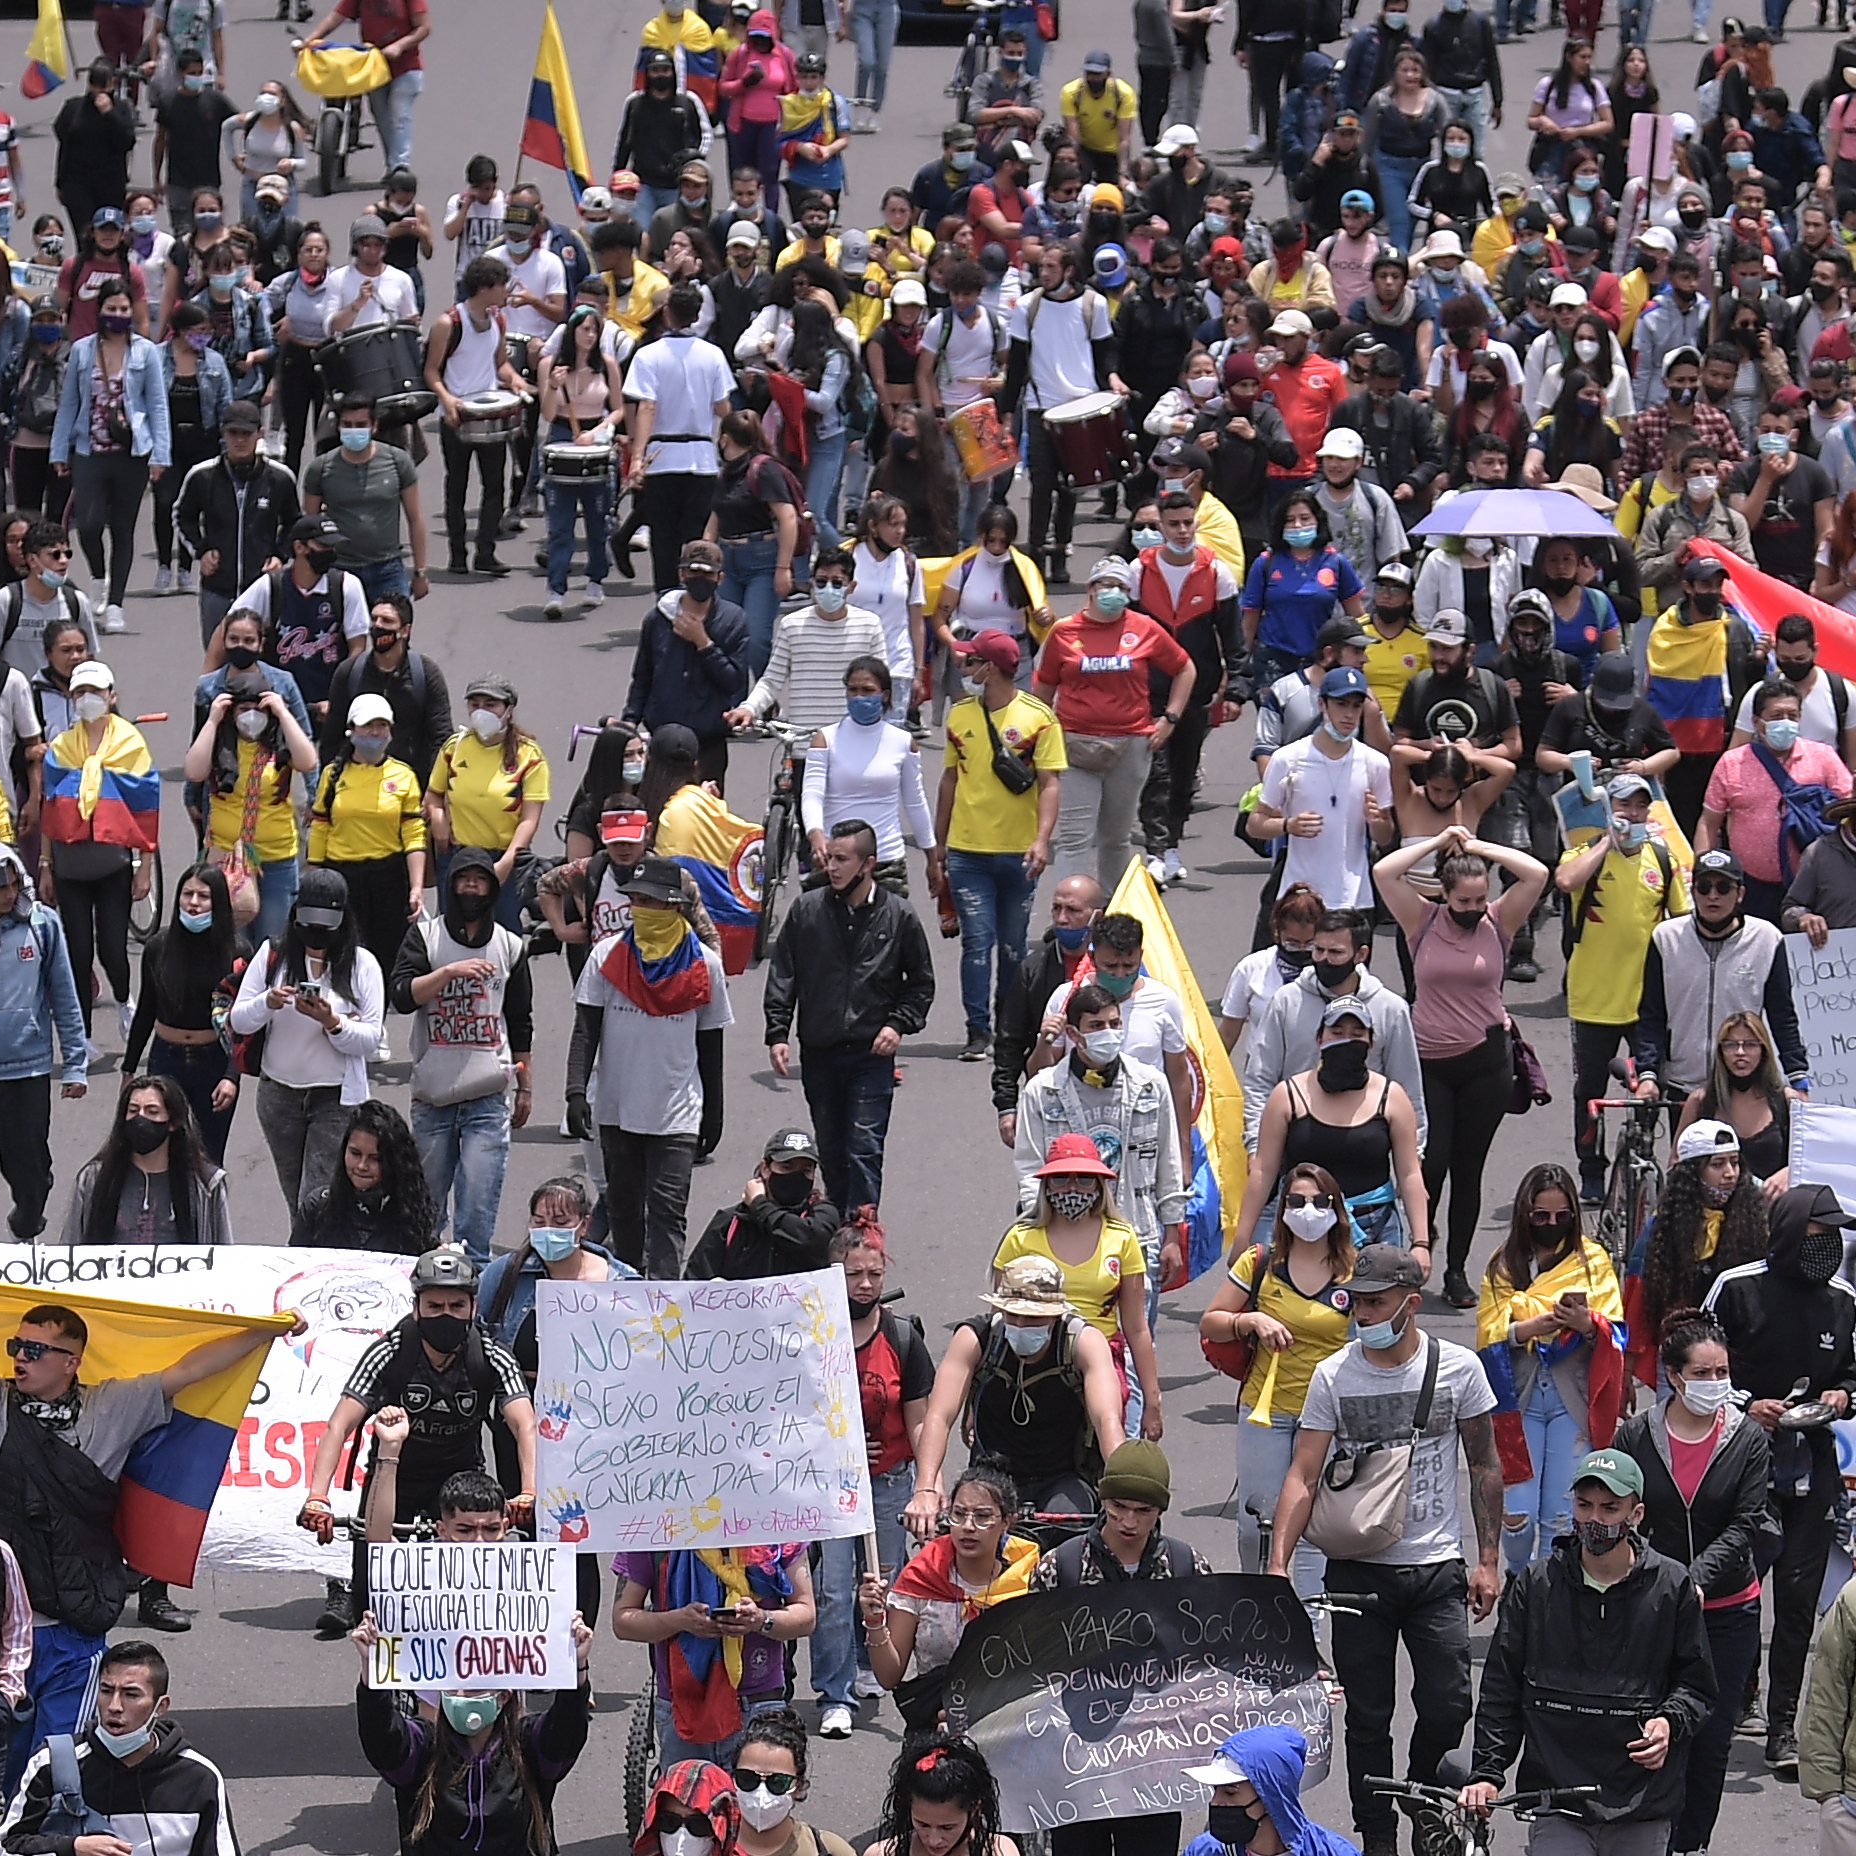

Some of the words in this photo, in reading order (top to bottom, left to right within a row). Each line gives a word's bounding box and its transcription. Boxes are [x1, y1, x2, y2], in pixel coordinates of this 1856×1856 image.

[597, 904, 633, 931] FUC
[441, 976, 484, 998] UCK
[441, 999, 474, 1018] THE
[558, 1288, 600, 1316] NO
[608, 1298, 638, 1312] A
[688, 1285, 798, 1313] REFORMA
[571, 1319, 632, 1374] NO
[659, 1318, 804, 1375] NECESITO
[408, 1418, 428, 1435] VA
[568, 1379, 658, 1431] SEXO
[567, 1418, 727, 1480] GOBIERNO
[1588, 1457, 1618, 1471] FILA
[585, 1466, 698, 1511] ENTIERRA
[369, 1545, 389, 1593] EL
[389, 1545, 433, 1593] QUE
[438, 1545, 465, 1592] NO
[470, 1545, 497, 1591] SE
[498, 1546, 558, 1592] MUEVE
[370, 1593, 396, 1635] NO
[400, 1593, 467, 1635] ESCUCHA
[474, 1594, 493, 1632] EL
[495, 1592, 550, 1633] RUIDO
[375, 1635, 404, 1685] DE
[409, 1635, 448, 1683] SUS
[455, 1634, 548, 1680] CADENAS
[979, 1624, 1033, 1680] EN
[1061, 1604, 1157, 1658] PARO
[1025, 1687, 1070, 1740] EN
